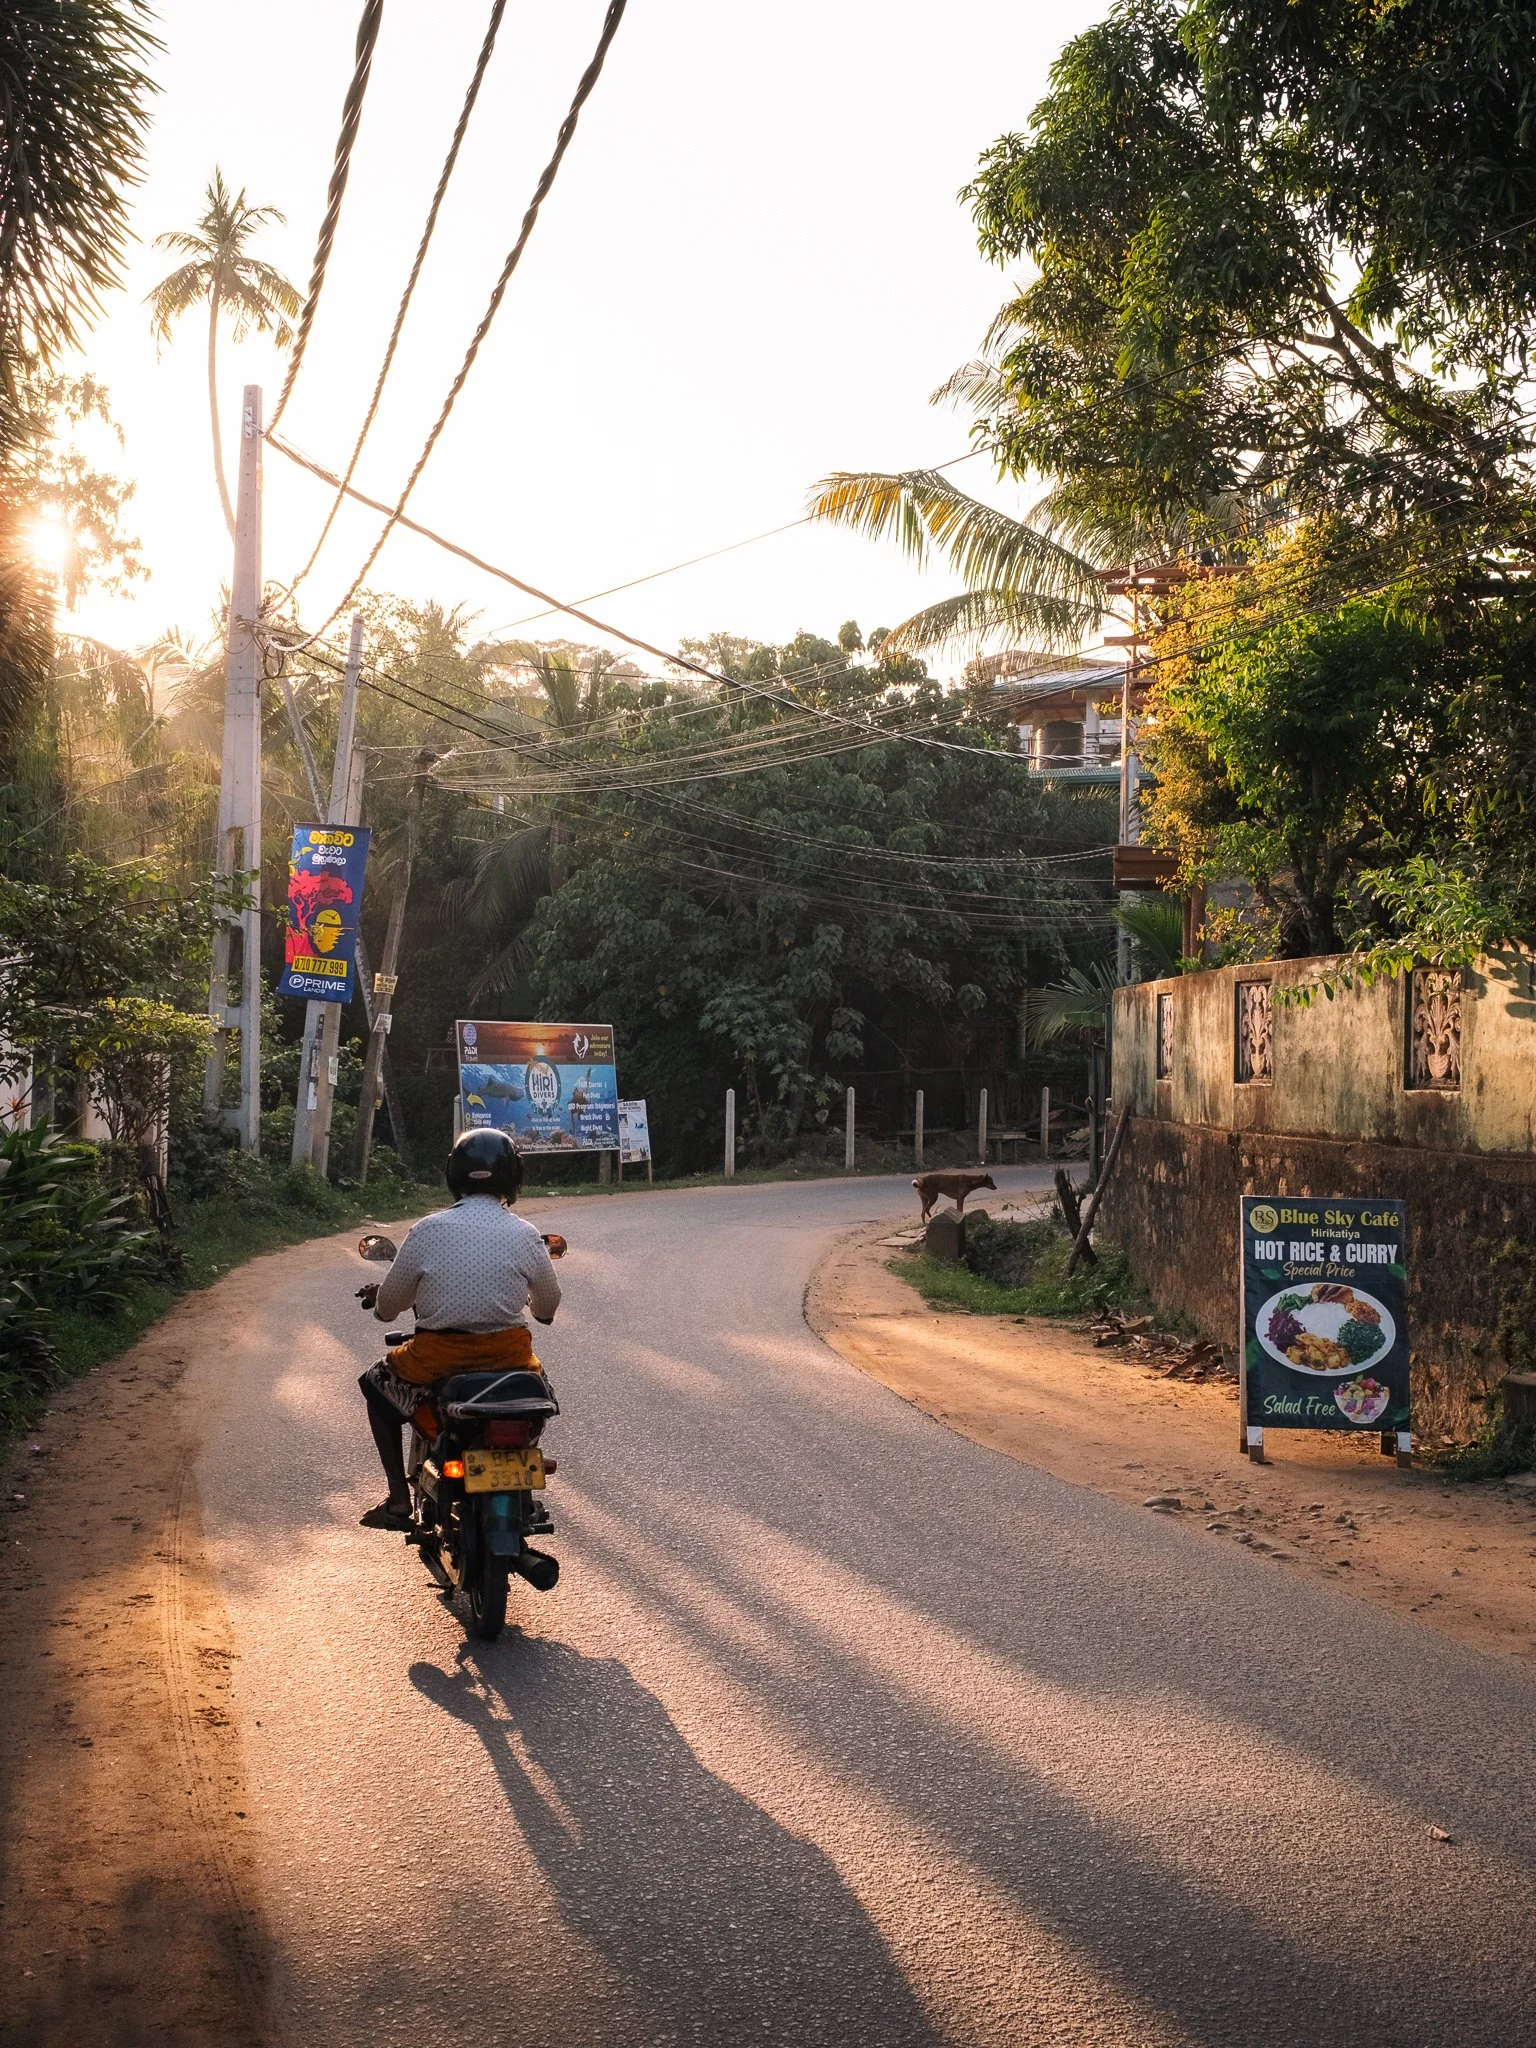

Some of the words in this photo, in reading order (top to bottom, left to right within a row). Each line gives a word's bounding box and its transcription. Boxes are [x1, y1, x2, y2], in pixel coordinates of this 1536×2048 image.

[294, 958, 310, 971] 0710
[312, 959, 328, 973] 777
[329, 961, 344, 975] 999
[304, 978, 346, 991] PRIME
[464, 1046, 478, 1054] PADI
[1280, 1208, 1318, 1224] Blue
[1324, 1210, 1355, 1228] Sky
[1360, 1211, 1399, 1227] Café
[1311, 1228, 1360, 1240] Hirikatiya
[1254, 1240, 1285, 1260] HOT
[1290, 1241, 1324, 1262] RICE
[1329, 1244, 1341, 1262] &
[1346, 1244, 1398, 1264] CURRY
[1283, 1261, 1323, 1280] Special
[1326, 1263, 1355, 1277] Price
[1263, 1394, 1303, 1417] Salad
[1305, 1396, 1336, 1416] Free
